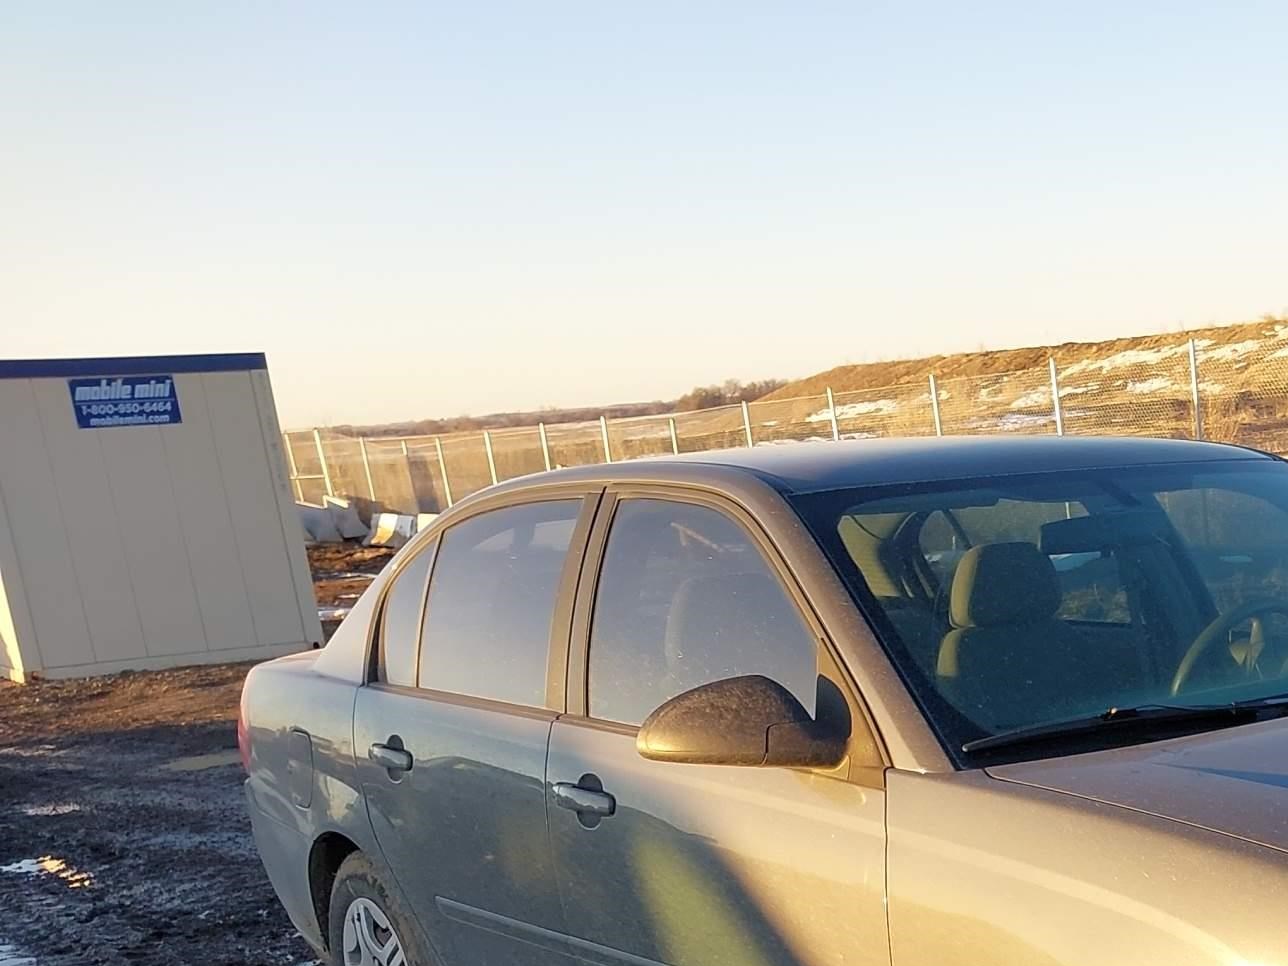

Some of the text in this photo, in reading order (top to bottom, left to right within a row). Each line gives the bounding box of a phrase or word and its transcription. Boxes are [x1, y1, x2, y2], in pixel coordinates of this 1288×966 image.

[75, 378, 172, 401] mobile mini
[90, 413, 170, 426] mobilemini.com
